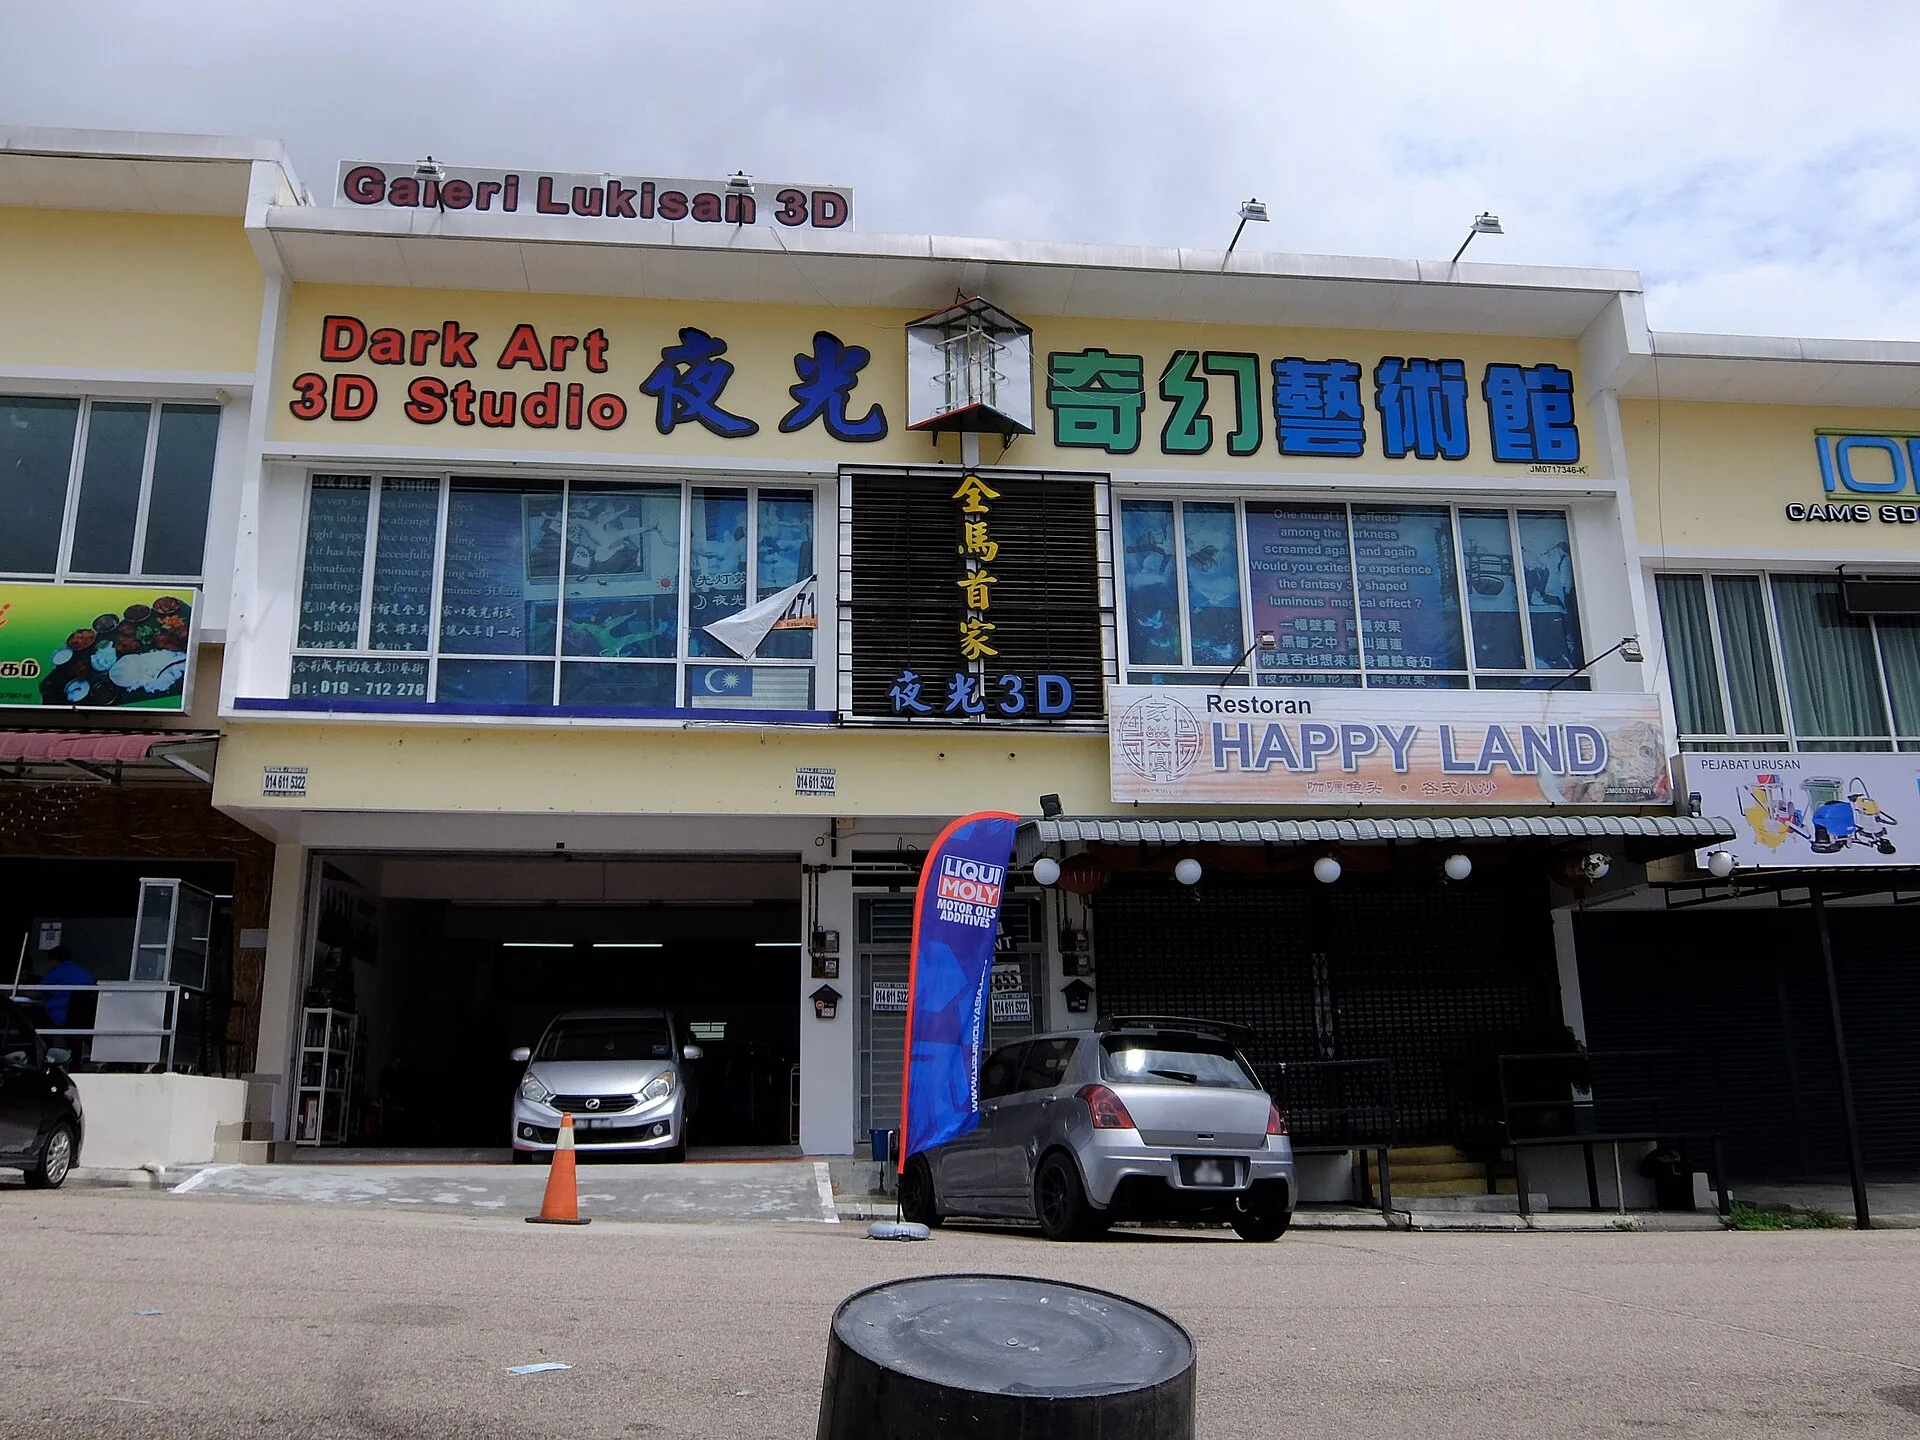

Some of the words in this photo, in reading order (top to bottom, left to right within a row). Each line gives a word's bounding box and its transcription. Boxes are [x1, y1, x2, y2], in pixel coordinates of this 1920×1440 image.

[343, 165, 519, 212] Galeri
[536, 176, 756, 225] Lukisan
[775, 188, 849, 229] 3D
[320, 315, 478, 368] Dark
[496, 321, 610, 373] Art
[639, 326, 888, 442] 夜光
[290, 372, 378, 421] 3D
[403, 376, 627, 430] Studio
[1047, 347, 1580, 464] 奇幻藝術館
[1273, 508, 1296, 519] One
[1301, 510, 1333, 521] mural
[1360, 513, 1398, 523] effects
[1786, 502, 1871, 522] CAMS
[1879, 505, 1920, 524] SD
[1280, 528, 1320, 540] among
[1323, 527, 1341, 538] the
[1346, 529, 1397, 540] arkness
[1264, 544, 1321, 555] screamed
[1325, 546, 1354, 557] agai
[1360, 546, 1381, 557] and
[1384, 547, 1415, 559] again
[952, 475, 1001, 661] 全馬首家
[1251, 560, 1288, 571] Would
[1291, 563, 1312, 574] you
[1369, 564, 1432, 576] experience
[1279, 579, 1297, 589] the
[1300, 579, 1342, 591] fantasy
[1365, 581, 1407, 593] shaped
[779, 592, 815, 621] 271
[1270, 596, 1324, 607] luminous
[1331, 597, 1376, 609] magcal
[1379, 598, 1411, 609] effect
[1281, 635, 1338, 649] 黑暗之中
[291, 681, 308, 694] el
[366, 682, 392, 695] 712
[889, 671, 1073, 714] 夜光3D
[1206, 694, 1312, 714] Restoran
[1210, 721, 1419, 774] HAPPY
[1438, 724, 1608, 775] LAND
[1701, 760, 1749, 770] PEJABAT
[1752, 760, 1801, 770] URUSAN
[265, 774, 277, 789] 014
[278, 775, 289, 789] 611
[796, 774, 808, 789] 014
[809, 775, 819, 789] 611
[1421, 781, 1497, 796] 各式小炒
[944, 857, 1002, 885] LIQUI
[941, 877, 999, 904] MOLY
[936, 898, 974, 915] MOTOR
[975, 905, 997, 919] OILS
[939, 910, 991, 929] ADDITIVES
[875, 989, 886, 1003] 014
[886, 990, 896, 1003] 611
